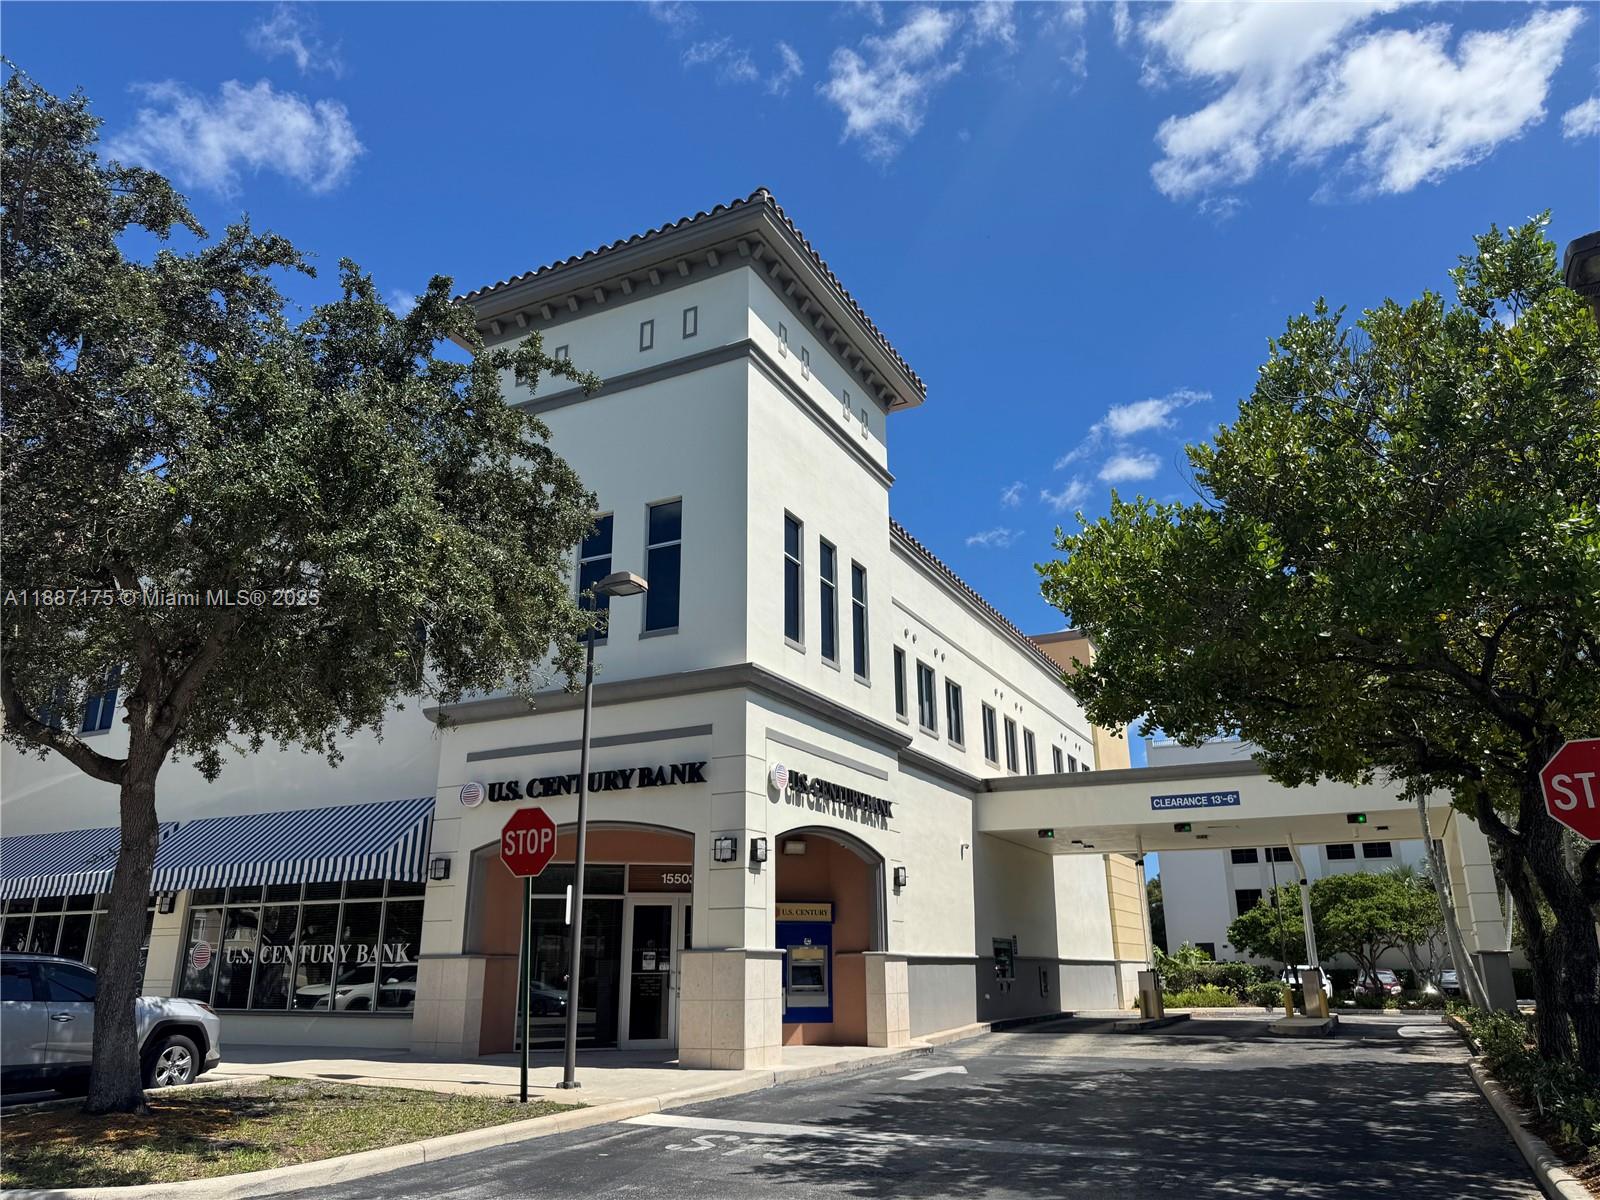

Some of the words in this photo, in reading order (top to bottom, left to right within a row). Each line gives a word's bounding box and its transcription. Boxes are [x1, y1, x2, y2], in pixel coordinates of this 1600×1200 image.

[488, 780, 523, 802] U.S.
[525, 767, 636, 799] CENTURY
[637, 761, 708, 792] BANK
[1153, 796, 1209, 808] CLEARANCE
[504, 828, 553, 856] STOP
[226, 947, 253, 964] U.S.
[260, 943, 352, 964] CENTURY
[356, 943, 411, 963] BANK
